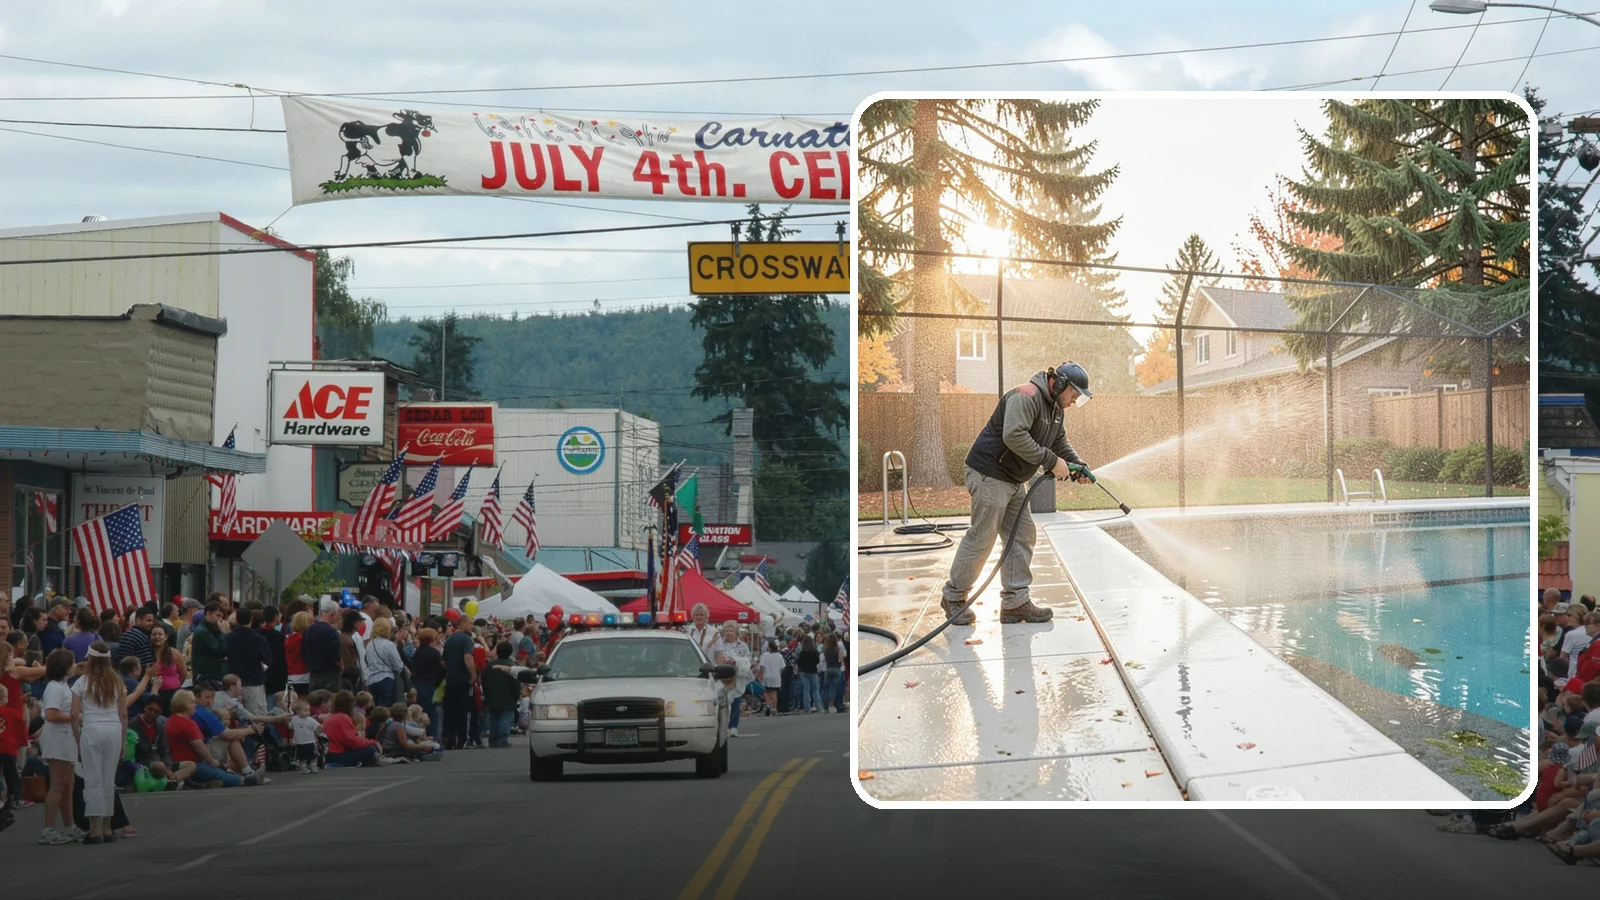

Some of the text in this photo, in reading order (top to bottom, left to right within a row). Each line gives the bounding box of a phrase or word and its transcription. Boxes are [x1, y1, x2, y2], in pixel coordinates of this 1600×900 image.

[481, 141, 605, 193] JULY
[632, 150, 747, 198] 4th.
[696, 254, 850, 281] CROSSWA
[282, 380, 373, 420] ACE
[405, 408, 453, 422] CEDAR
[283, 421, 371, 437] Hardware
[416, 427, 477, 447] Coca-Cola
[95, 485, 124, 495] Vincent
[126, 486, 136, 495] de
[138, 486, 155, 495] Paul
[688, 526, 741, 535] CRNATION
[699, 535, 730, 543] GLASS
